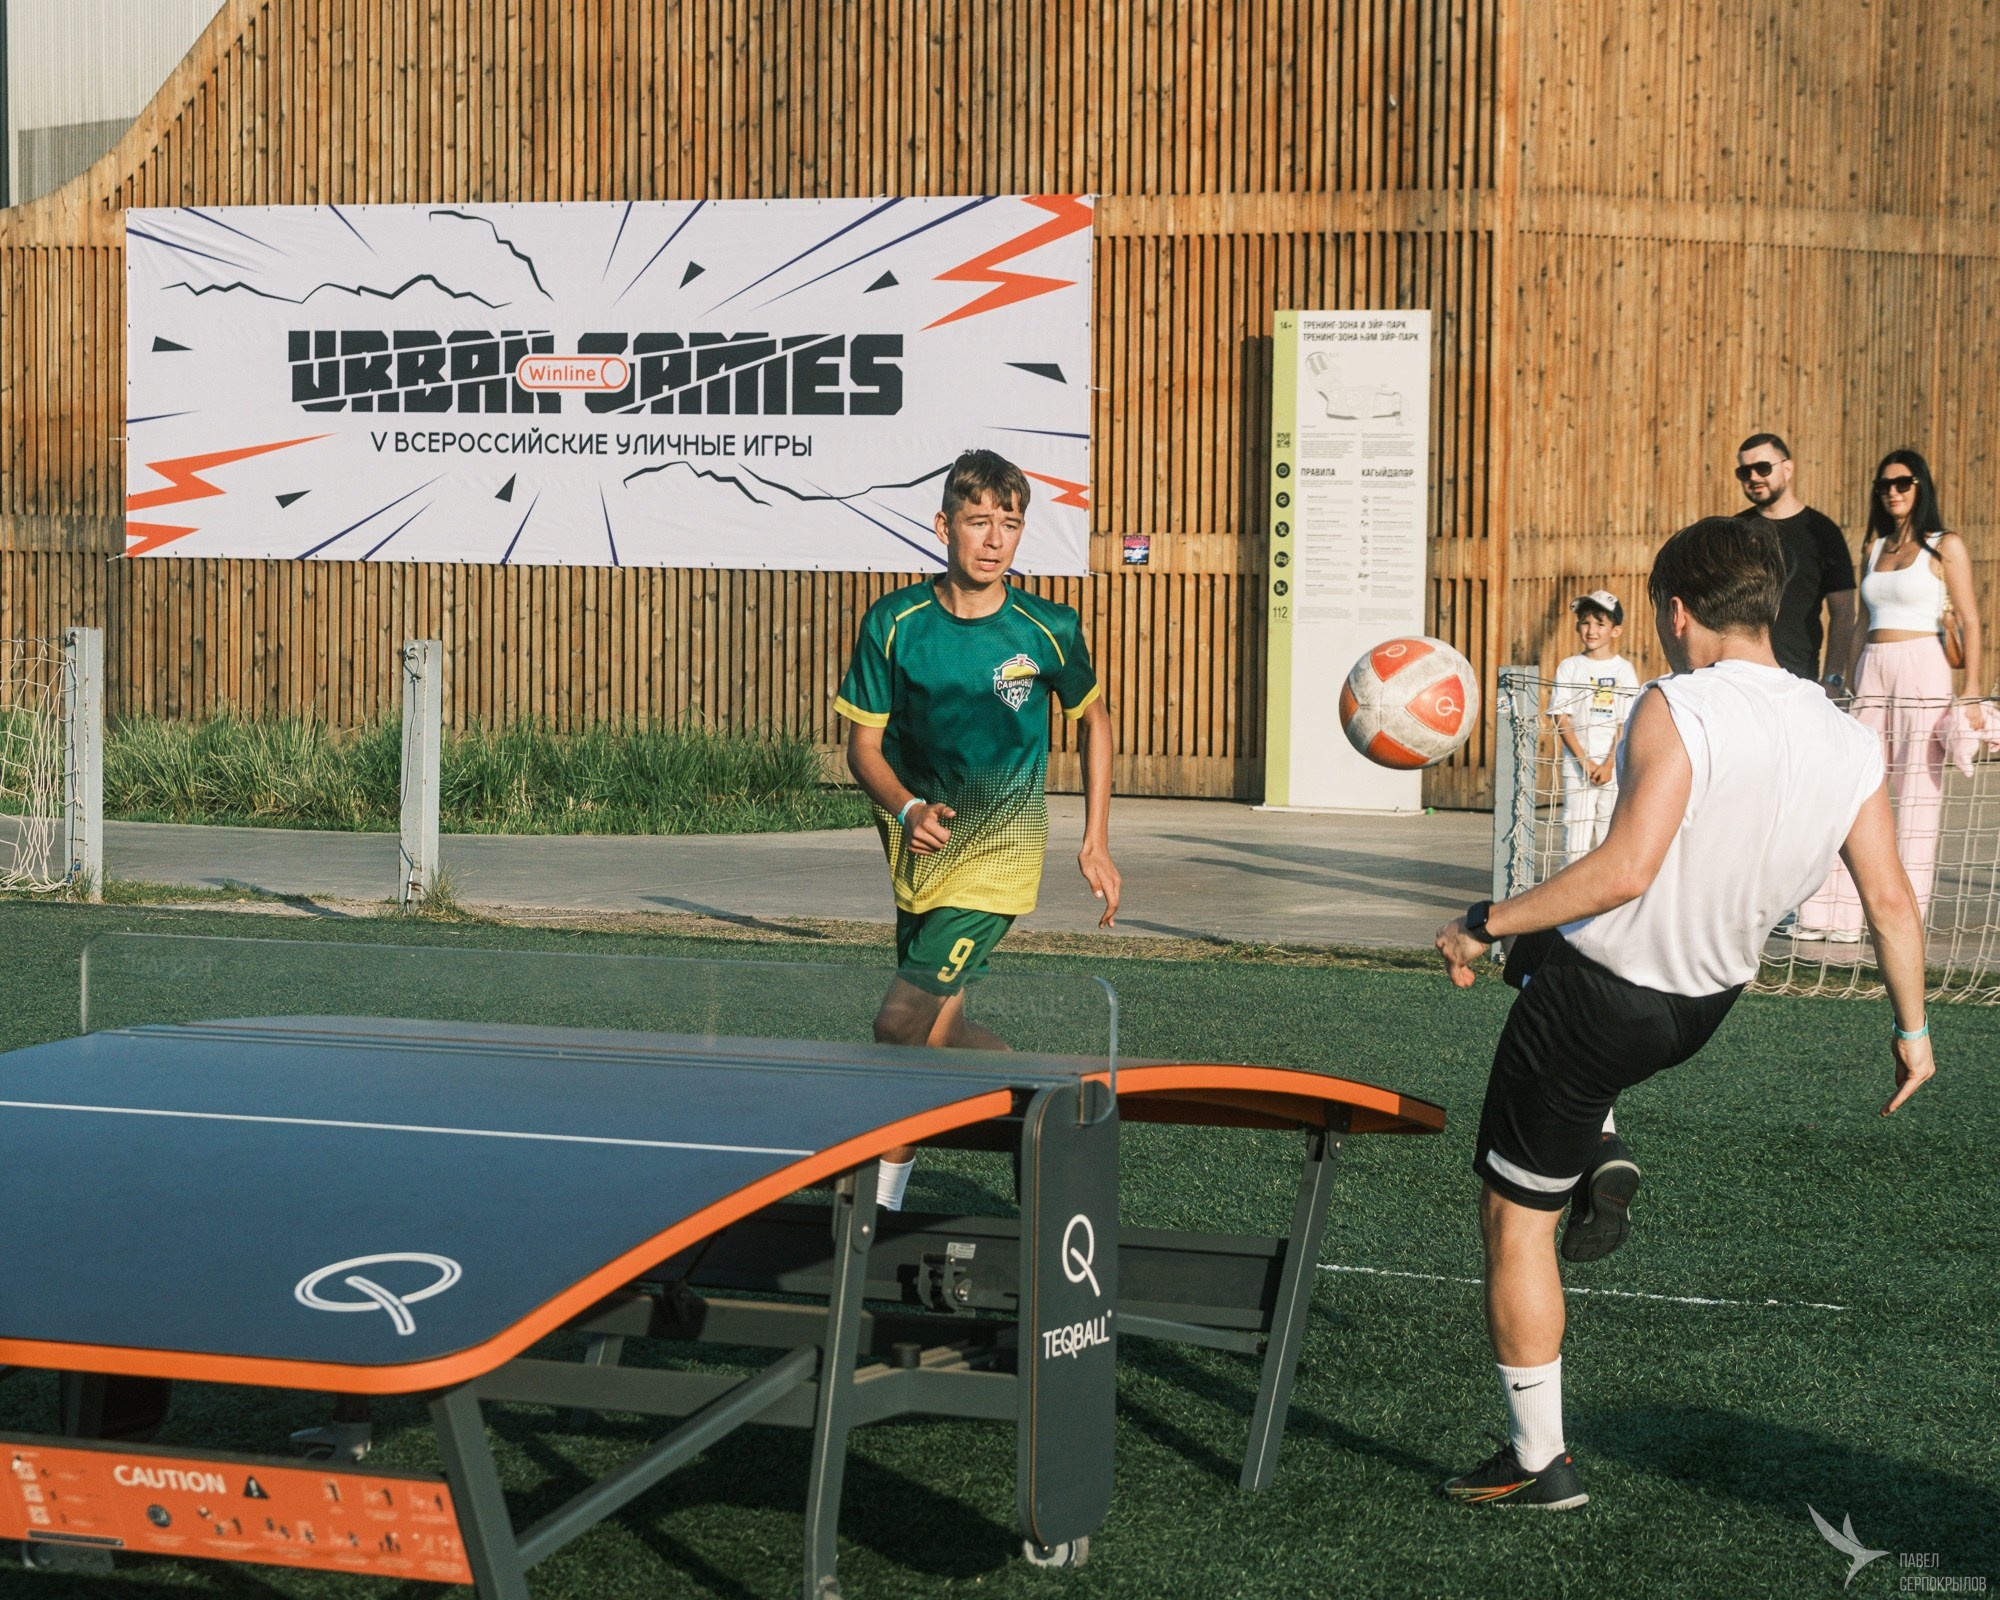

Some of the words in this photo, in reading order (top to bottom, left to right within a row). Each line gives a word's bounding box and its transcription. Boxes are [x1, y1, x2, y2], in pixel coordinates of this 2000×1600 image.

[1360, 320, 1366, 329] И
[288, 330, 562, 414] URBAN
[528, 365, 597, 382] Winline
[370, 431, 388, 452] V
[394, 427, 608, 455] ВСЕРОССИЙСКИЕ
[615, 433, 736, 456] УЛИЧНЫЕ
[744, 434, 812, 457] ИГРЫ
[1300, 468, 1336, 477] ПРАВИЛА
[1273, 606, 1288, 619] 112
[937, 937, 975, 983] 9
[1042, 1315, 1111, 1360] TEQBALL
[113, 1464, 227, 1495] CAUTION
